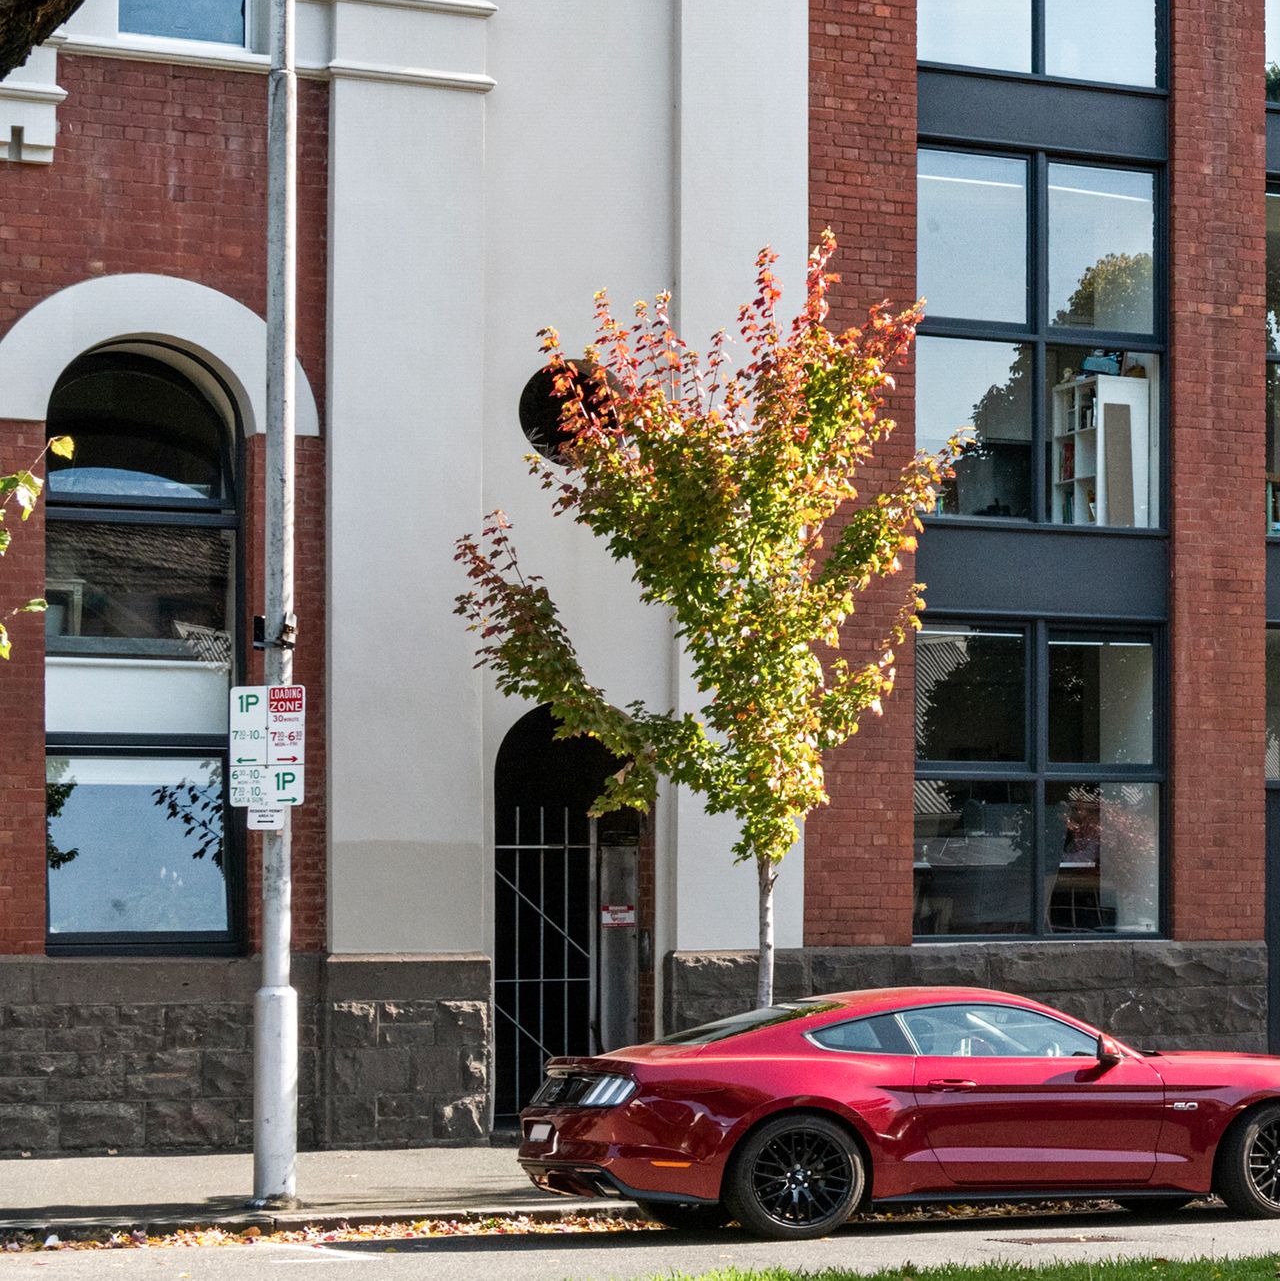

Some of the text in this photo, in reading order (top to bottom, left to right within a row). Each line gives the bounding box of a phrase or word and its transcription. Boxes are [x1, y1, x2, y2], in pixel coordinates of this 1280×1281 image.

[270, 688, 302, 699] LOADING
[238, 694, 259, 713] 1P
[270, 701, 302, 711] ZONE
[275, 772, 296, 790] 1P
